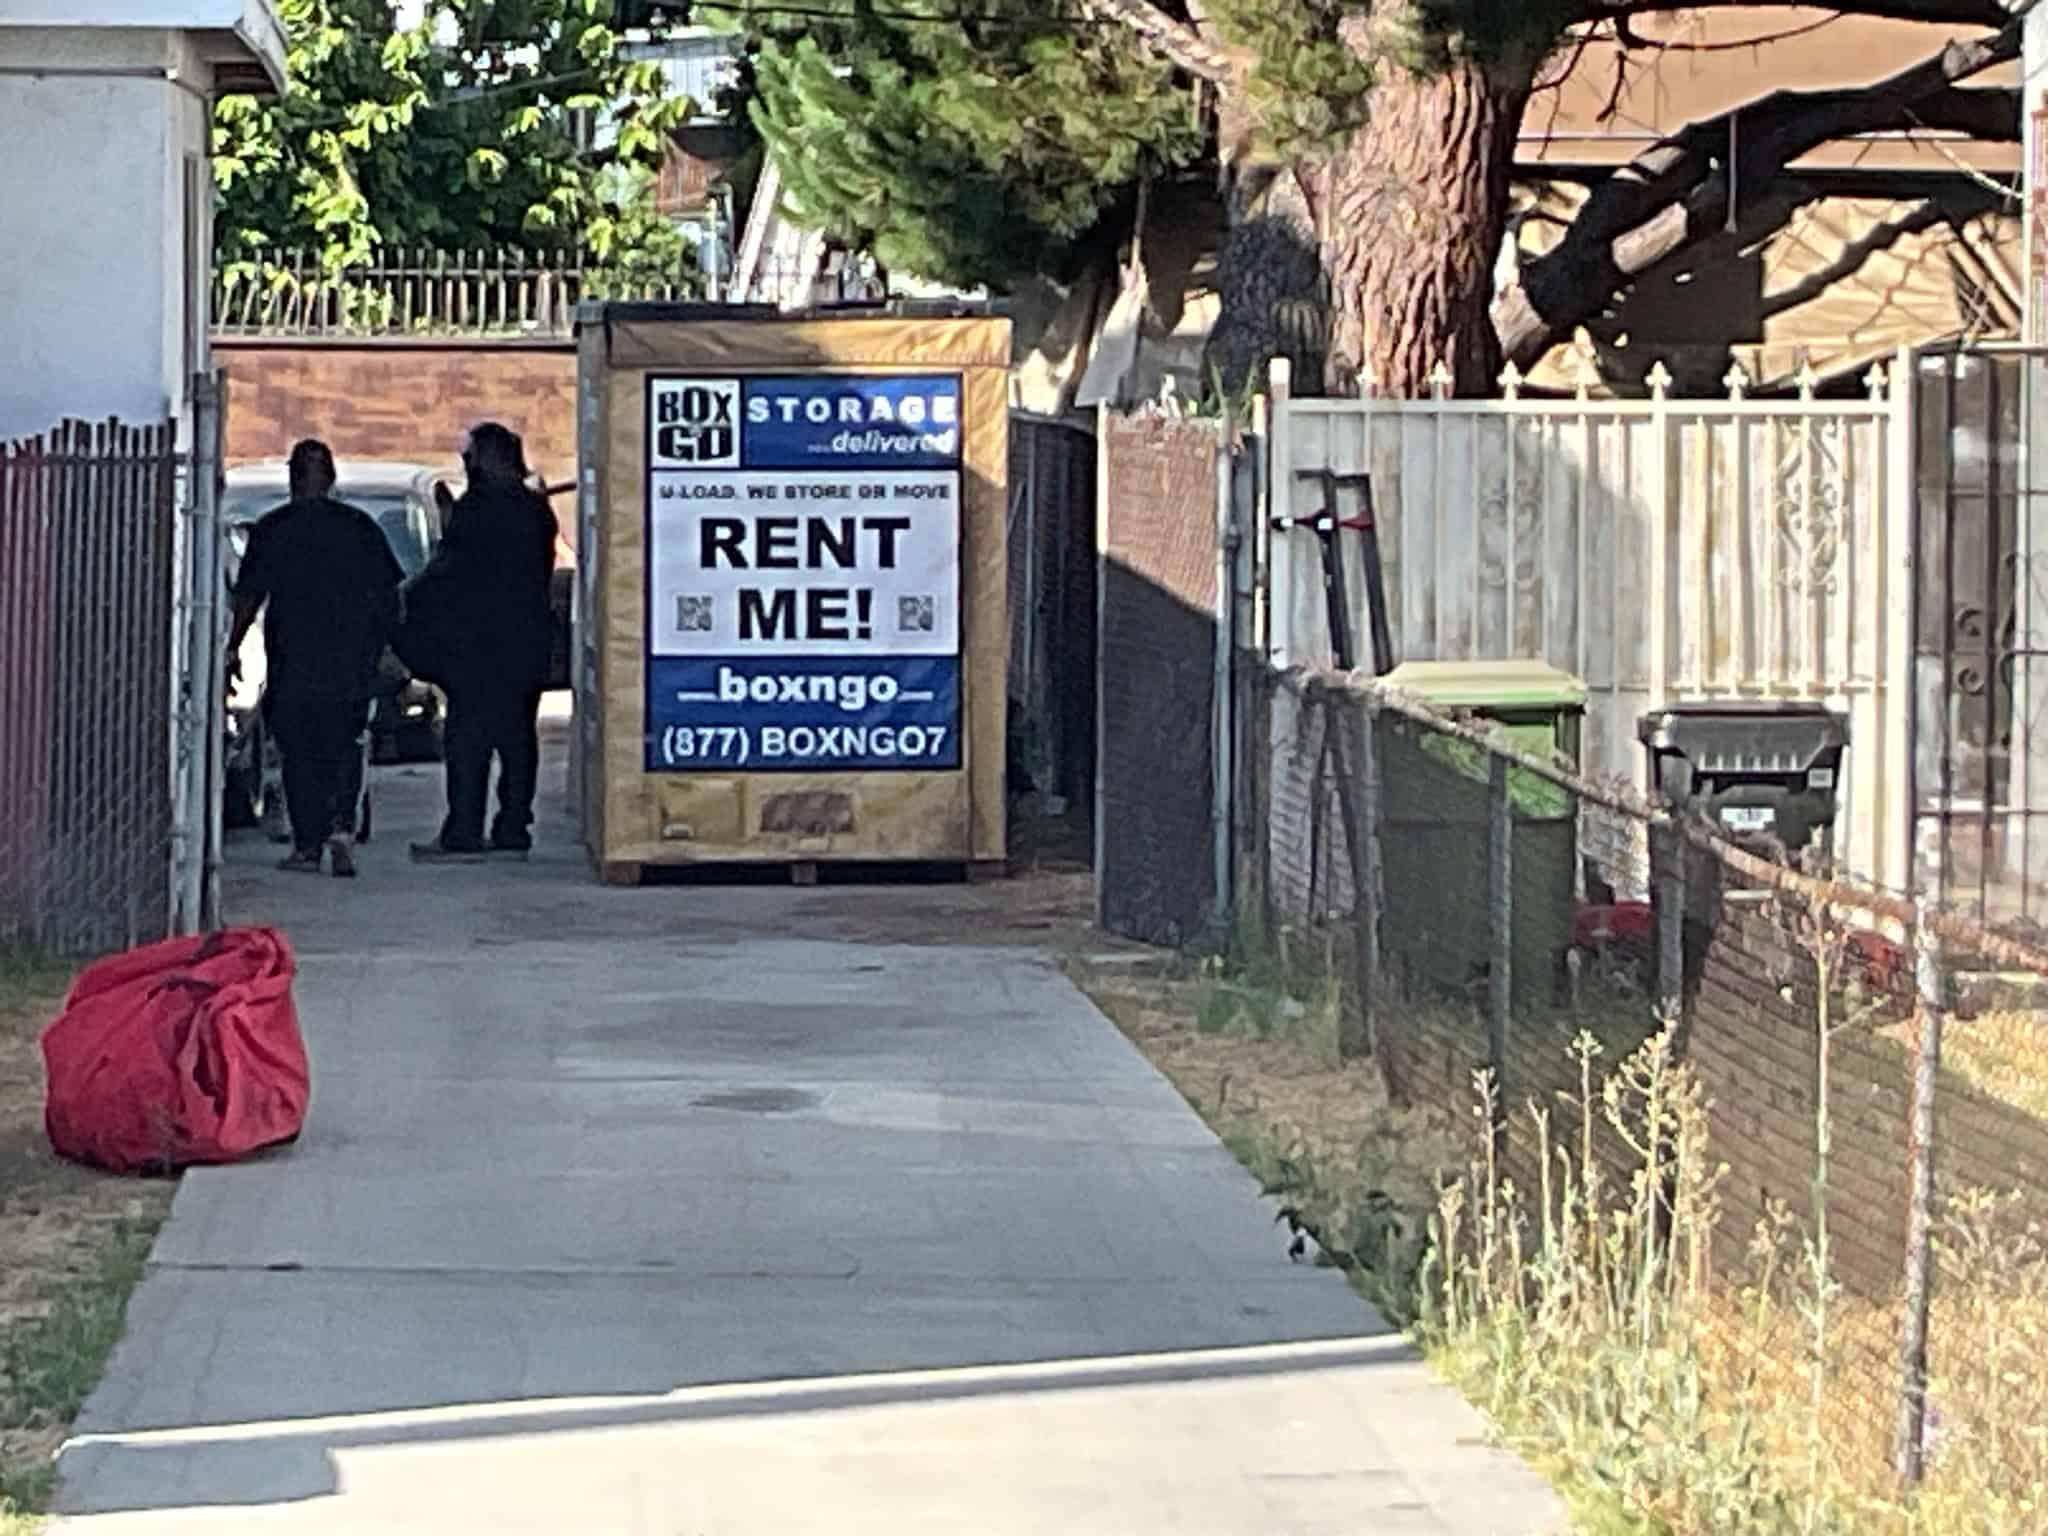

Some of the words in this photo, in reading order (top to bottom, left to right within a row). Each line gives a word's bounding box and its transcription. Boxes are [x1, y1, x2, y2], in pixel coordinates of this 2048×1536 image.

[658, 386, 732, 423] BOX
[747, 395, 958, 423] STORAGE
[658, 425, 732, 461] GO
[747, 485, 777, 499] WE
[785, 485, 851, 499] STORE
[858, 485, 886, 499] OR
[893, 485, 950, 499] MOVE
[699, 516, 911, 569] RENT
[738, 588, 873, 640] ME!
[662, 725, 750, 765] (877)
[761, 725, 948, 757] BOXNGO7
